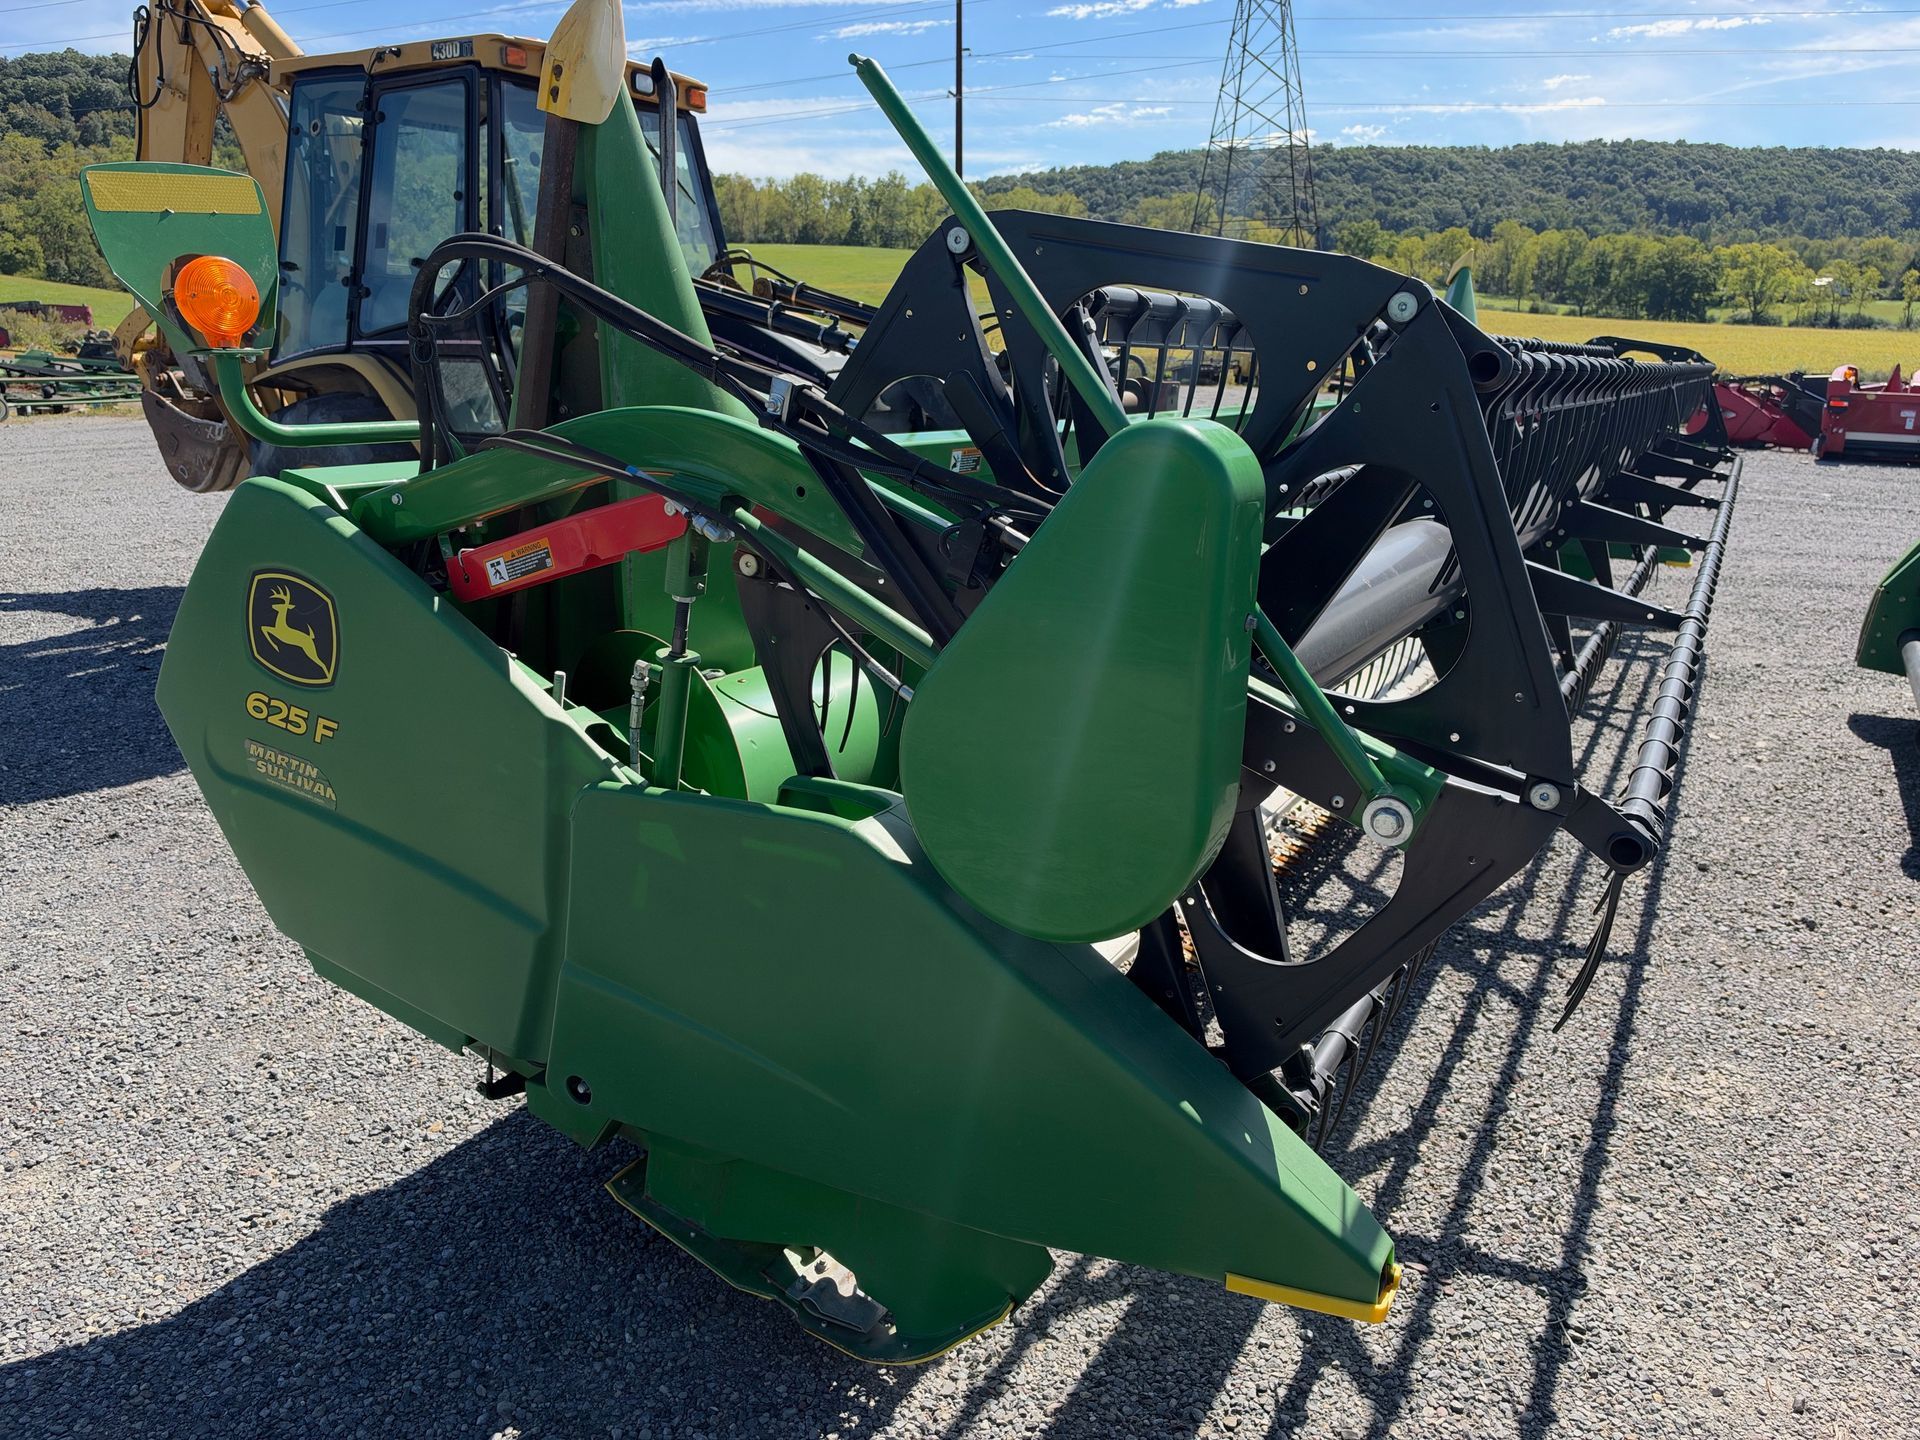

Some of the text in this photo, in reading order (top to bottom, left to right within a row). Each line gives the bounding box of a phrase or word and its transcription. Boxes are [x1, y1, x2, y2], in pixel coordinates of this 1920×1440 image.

[433, 42, 460, 60] 430D
[516, 542, 542, 554] WARNING
[245, 691, 339, 744] 625 F
[249, 743, 318, 778] MARTIN
